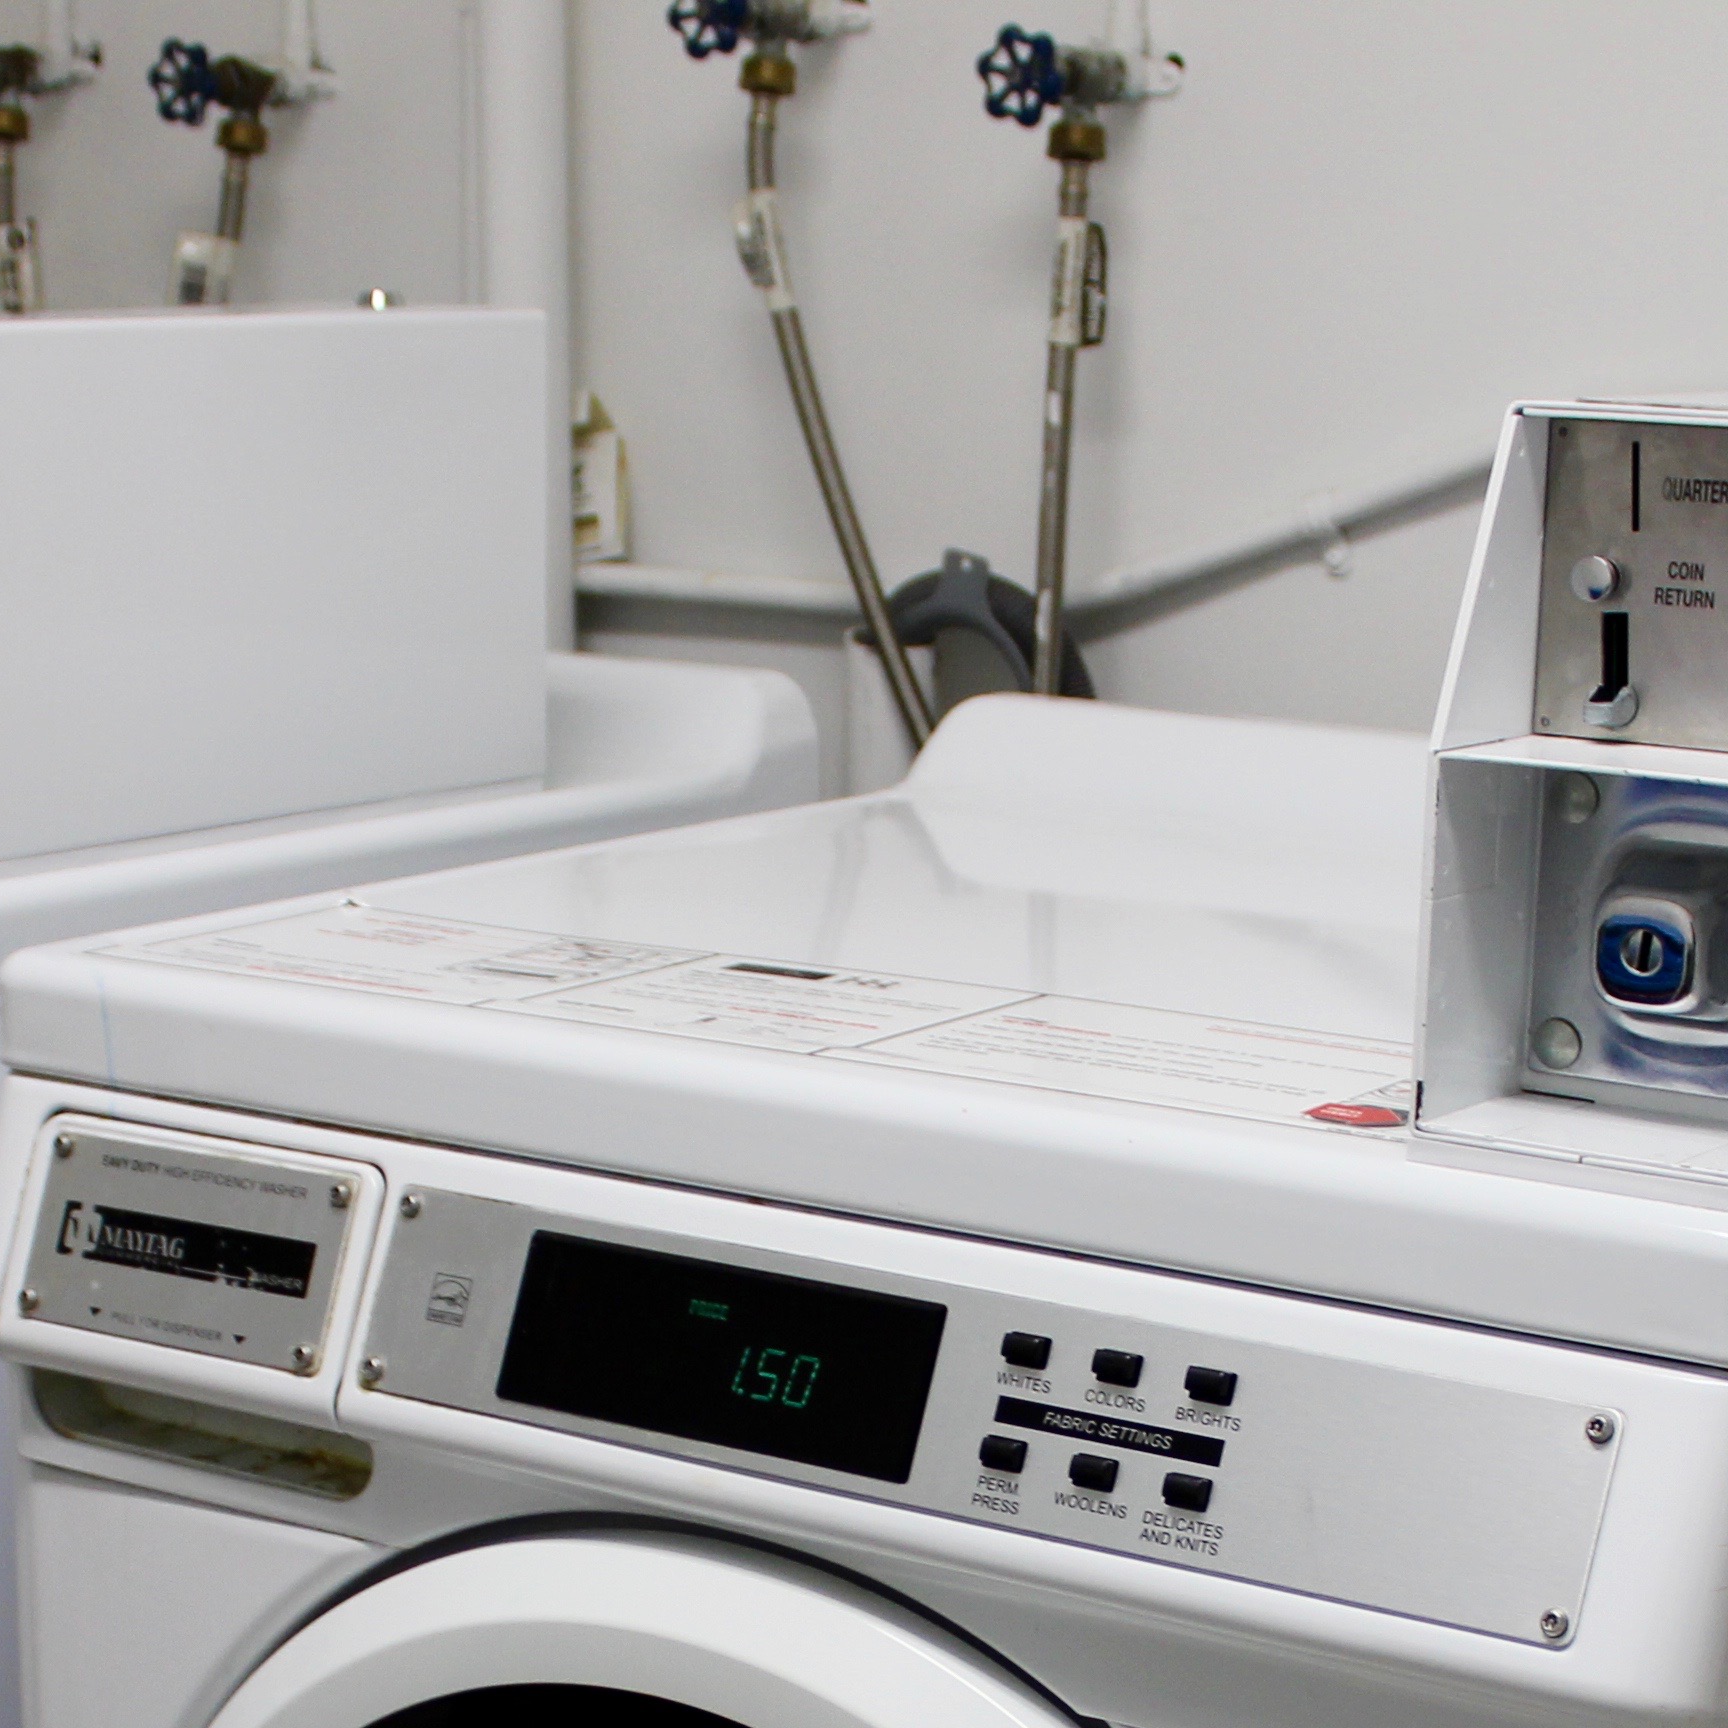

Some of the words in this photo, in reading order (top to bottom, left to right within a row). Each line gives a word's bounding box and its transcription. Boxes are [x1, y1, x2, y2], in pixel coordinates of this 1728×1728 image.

[1667, 561, 1705, 581] COIN
[1654, 587, 1715, 609] RETURN
[101, 1224, 185, 1259] MAYTAG
[996, 1371, 1052, 1394] WHITES
[1084, 1388, 1146, 1412] COLORS
[1042, 1411, 1097, 1435] FABRIC
[1098, 1422, 1173, 1450] SETTINGS
[1175, 1406, 1242, 1432] BRIGHTS
[972, 1494, 1020, 1516] PRESS
[1054, 1492, 1127, 1519] WOOLENS
[1142, 1510, 1223, 1539] DELICATES
[1139, 1528, 1171, 1547] AND
[1174, 1536, 1219, 1557] KNITS
